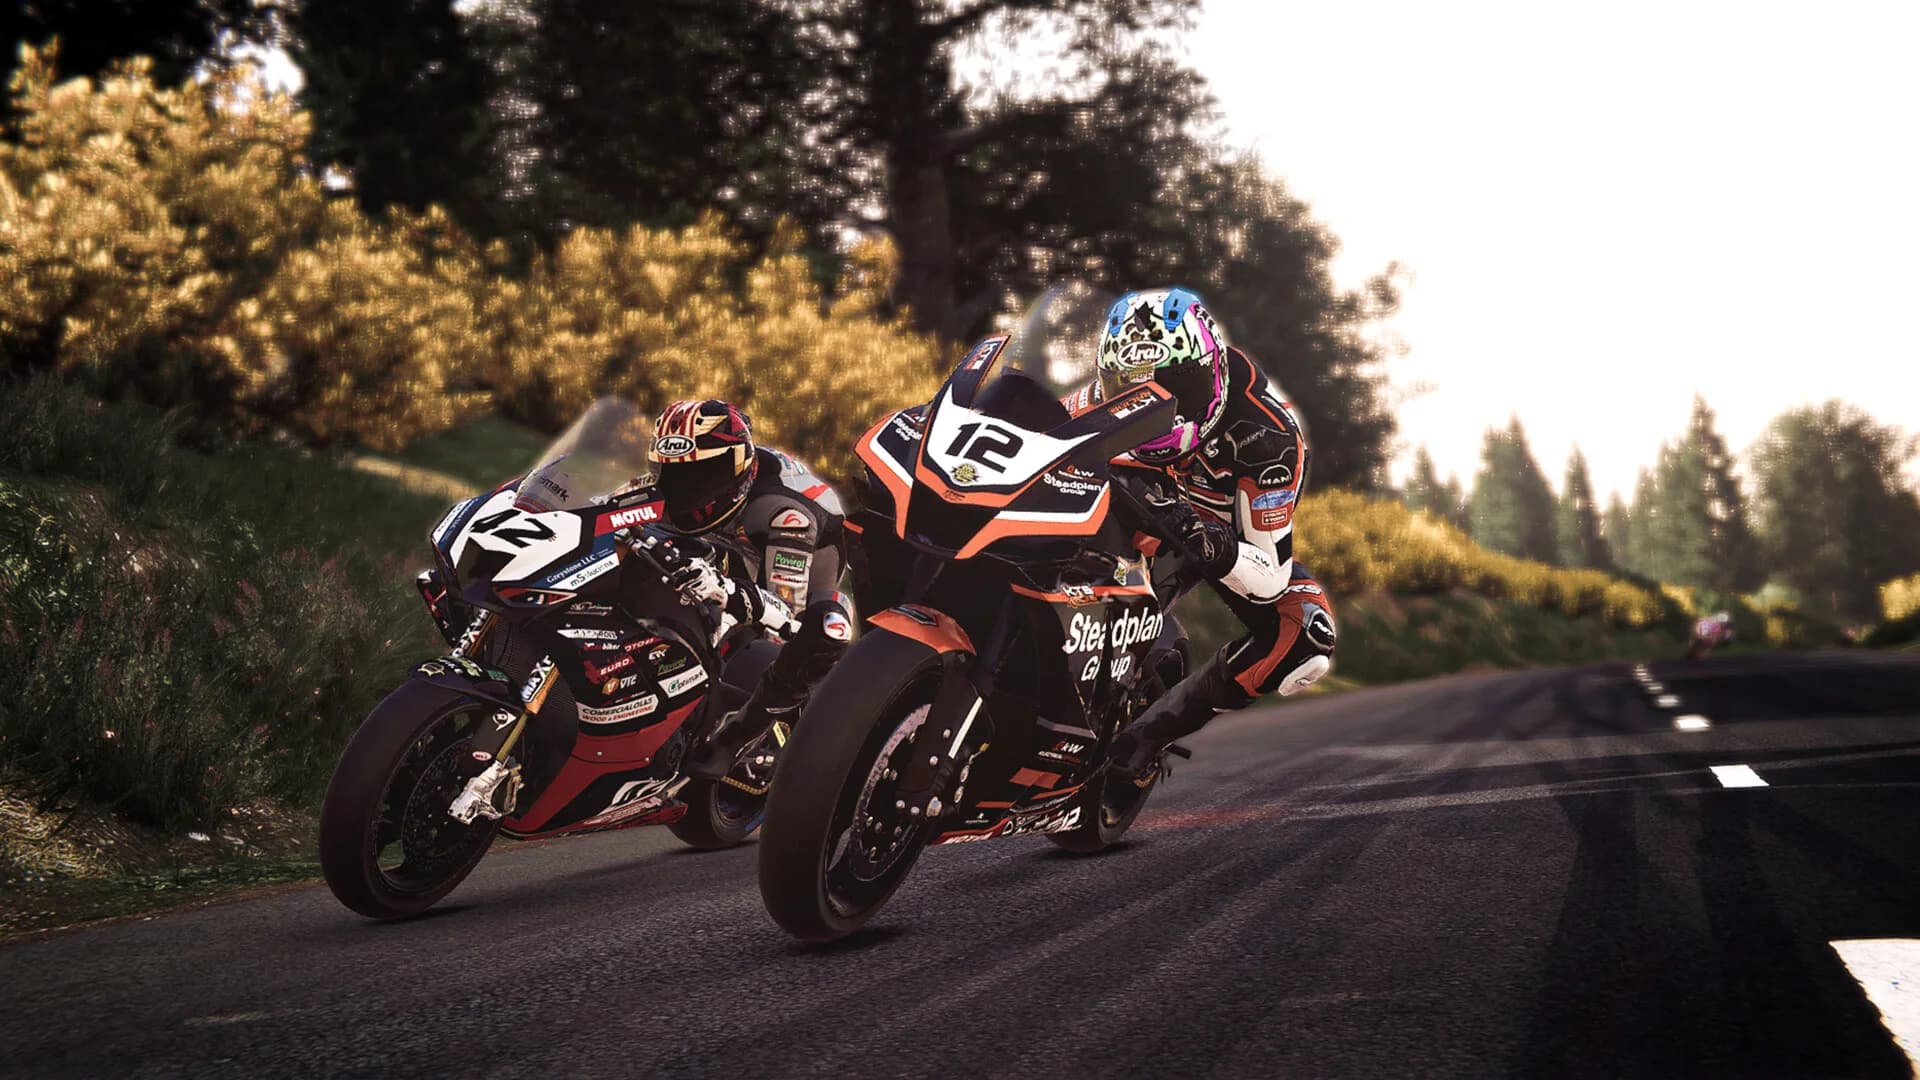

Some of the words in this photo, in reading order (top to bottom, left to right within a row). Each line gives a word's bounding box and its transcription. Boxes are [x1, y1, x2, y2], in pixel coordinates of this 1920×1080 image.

[1123, 343, 1163, 360] Arai
[659, 439, 687, 450] Arai
[945, 422, 1024, 474] 12
[1043, 472, 1101, 491] Steadplan
[1262, 475, 1290, 485] MAN
[609, 506, 657, 528] MOTUL
[580, 554, 597, 566] LLC
[1062, 606, 1164, 654] Steadplan
[600, 658, 630, 676] EURO
[1081, 655, 1131, 682] Grup
[582, 714, 607, 722] WOOD
